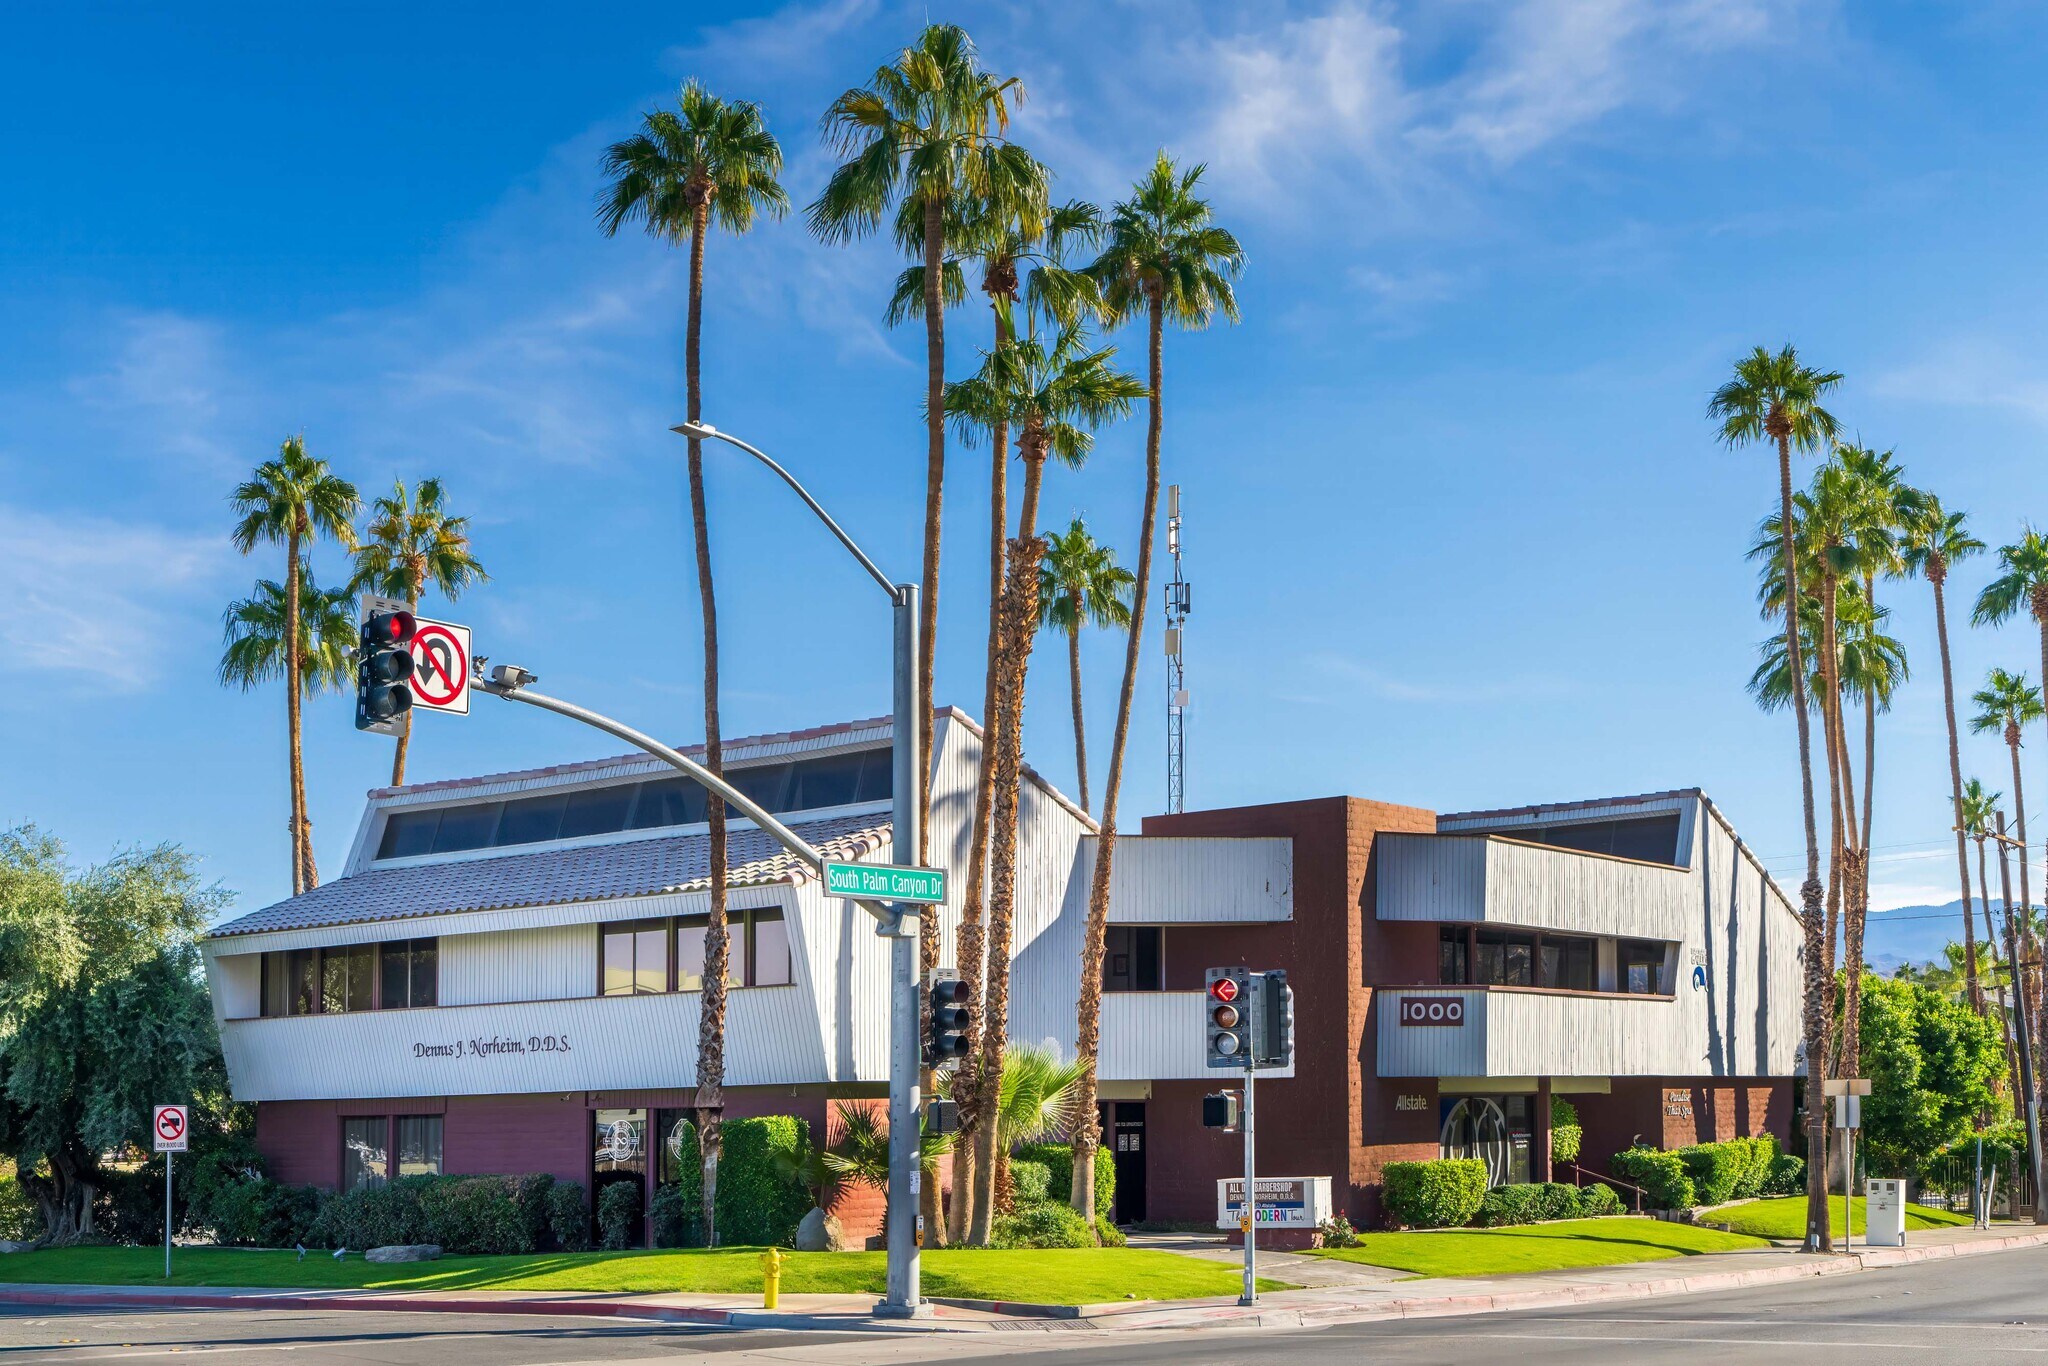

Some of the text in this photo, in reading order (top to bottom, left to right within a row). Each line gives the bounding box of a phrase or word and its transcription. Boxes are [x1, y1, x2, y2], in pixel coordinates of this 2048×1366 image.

[829, 869, 942, 897] South Palm Canyon Dr
[1403, 1002, 1462, 1020] 1000
[413, 1035, 572, 1059] Dennis J. Norheim, D.D.S.
[1229, 1183, 1240, 1193] ALL
[1254, 1181, 1293, 1193] BARBERSHOP
[1254, 1209, 1287, 1222] ODERN
[1287, 1209, 1304, 1221] Tour
